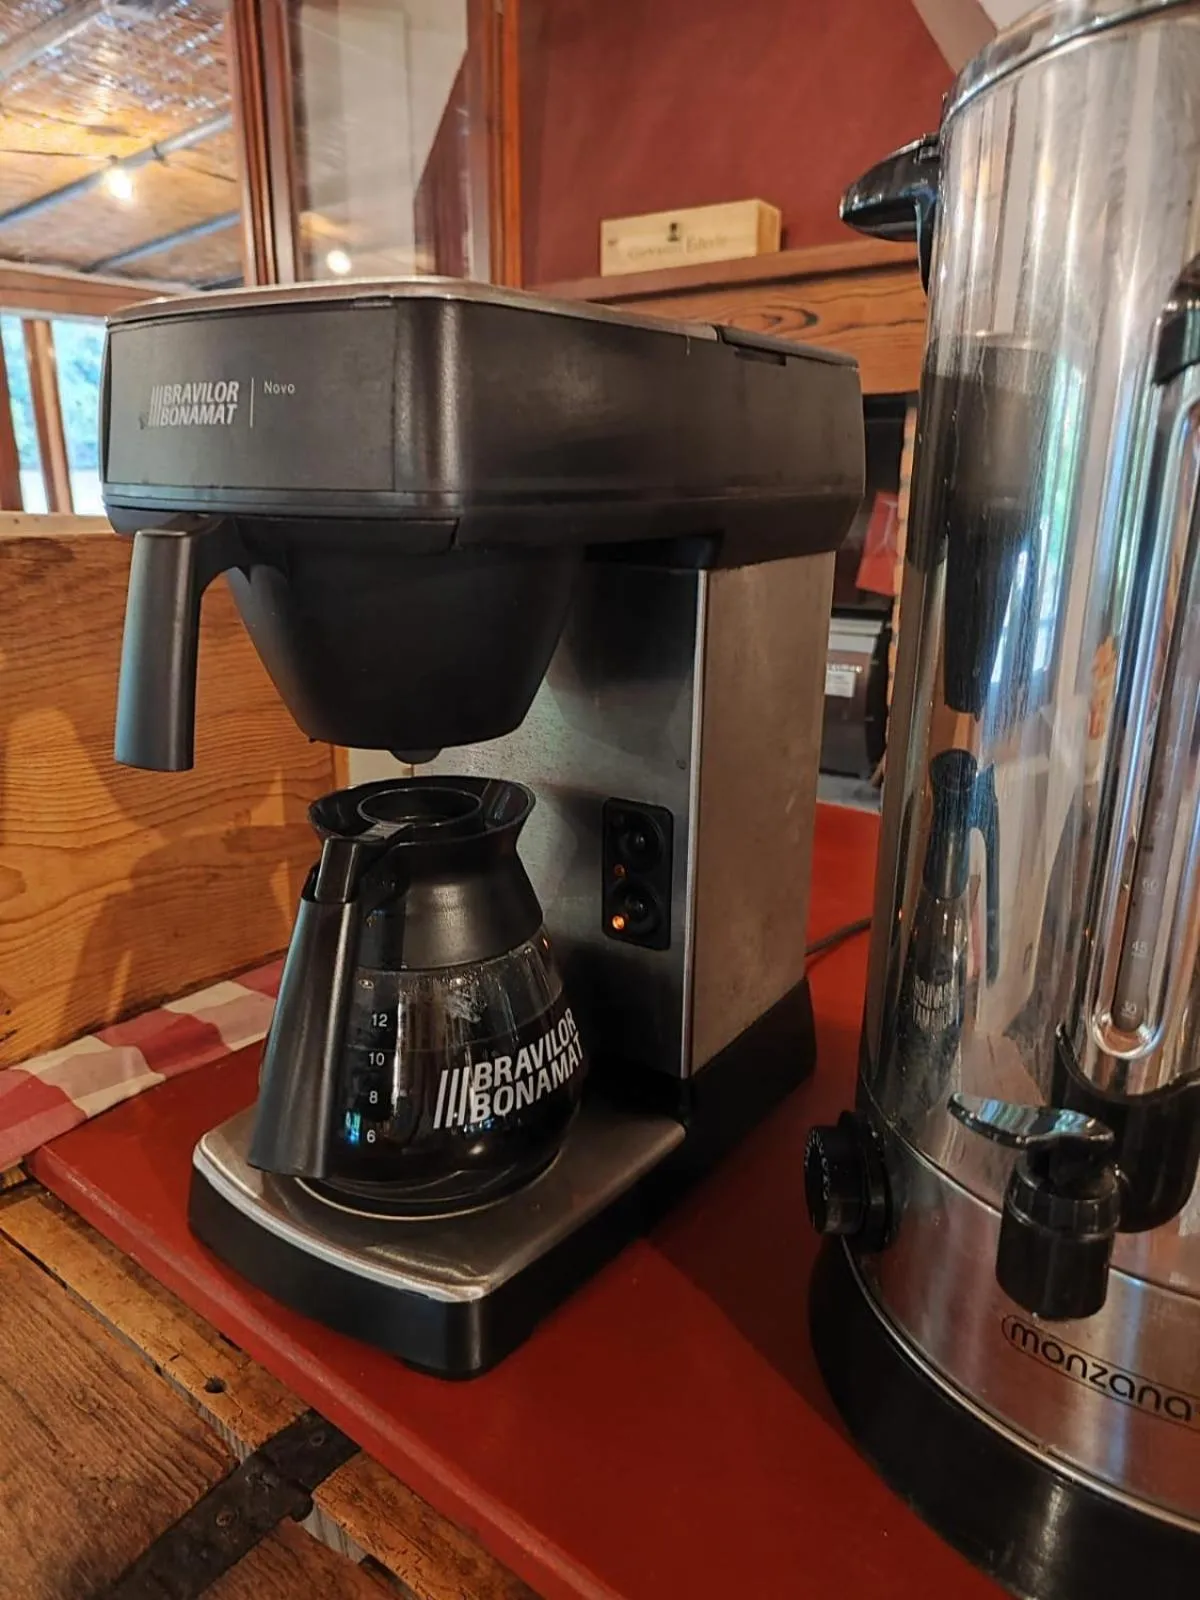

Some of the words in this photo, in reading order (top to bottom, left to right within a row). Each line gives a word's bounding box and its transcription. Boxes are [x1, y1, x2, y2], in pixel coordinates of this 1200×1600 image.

[163, 381, 239, 404] BRAVILOR
[264, 380, 296, 394] Novo
[160, 403, 238, 426] BONAMAT
[372, 1014, 388, 1027] 12
[473, 1007, 577, 1092] BRAVILOR
[369, 1052, 385, 1066] 10
[470, 1031, 583, 1123] BONAMAT
[369, 1090, 378, 1104] 8
[367, 1130, 376, 1143] 6
[1010, 1322, 1192, 1423] monzana
